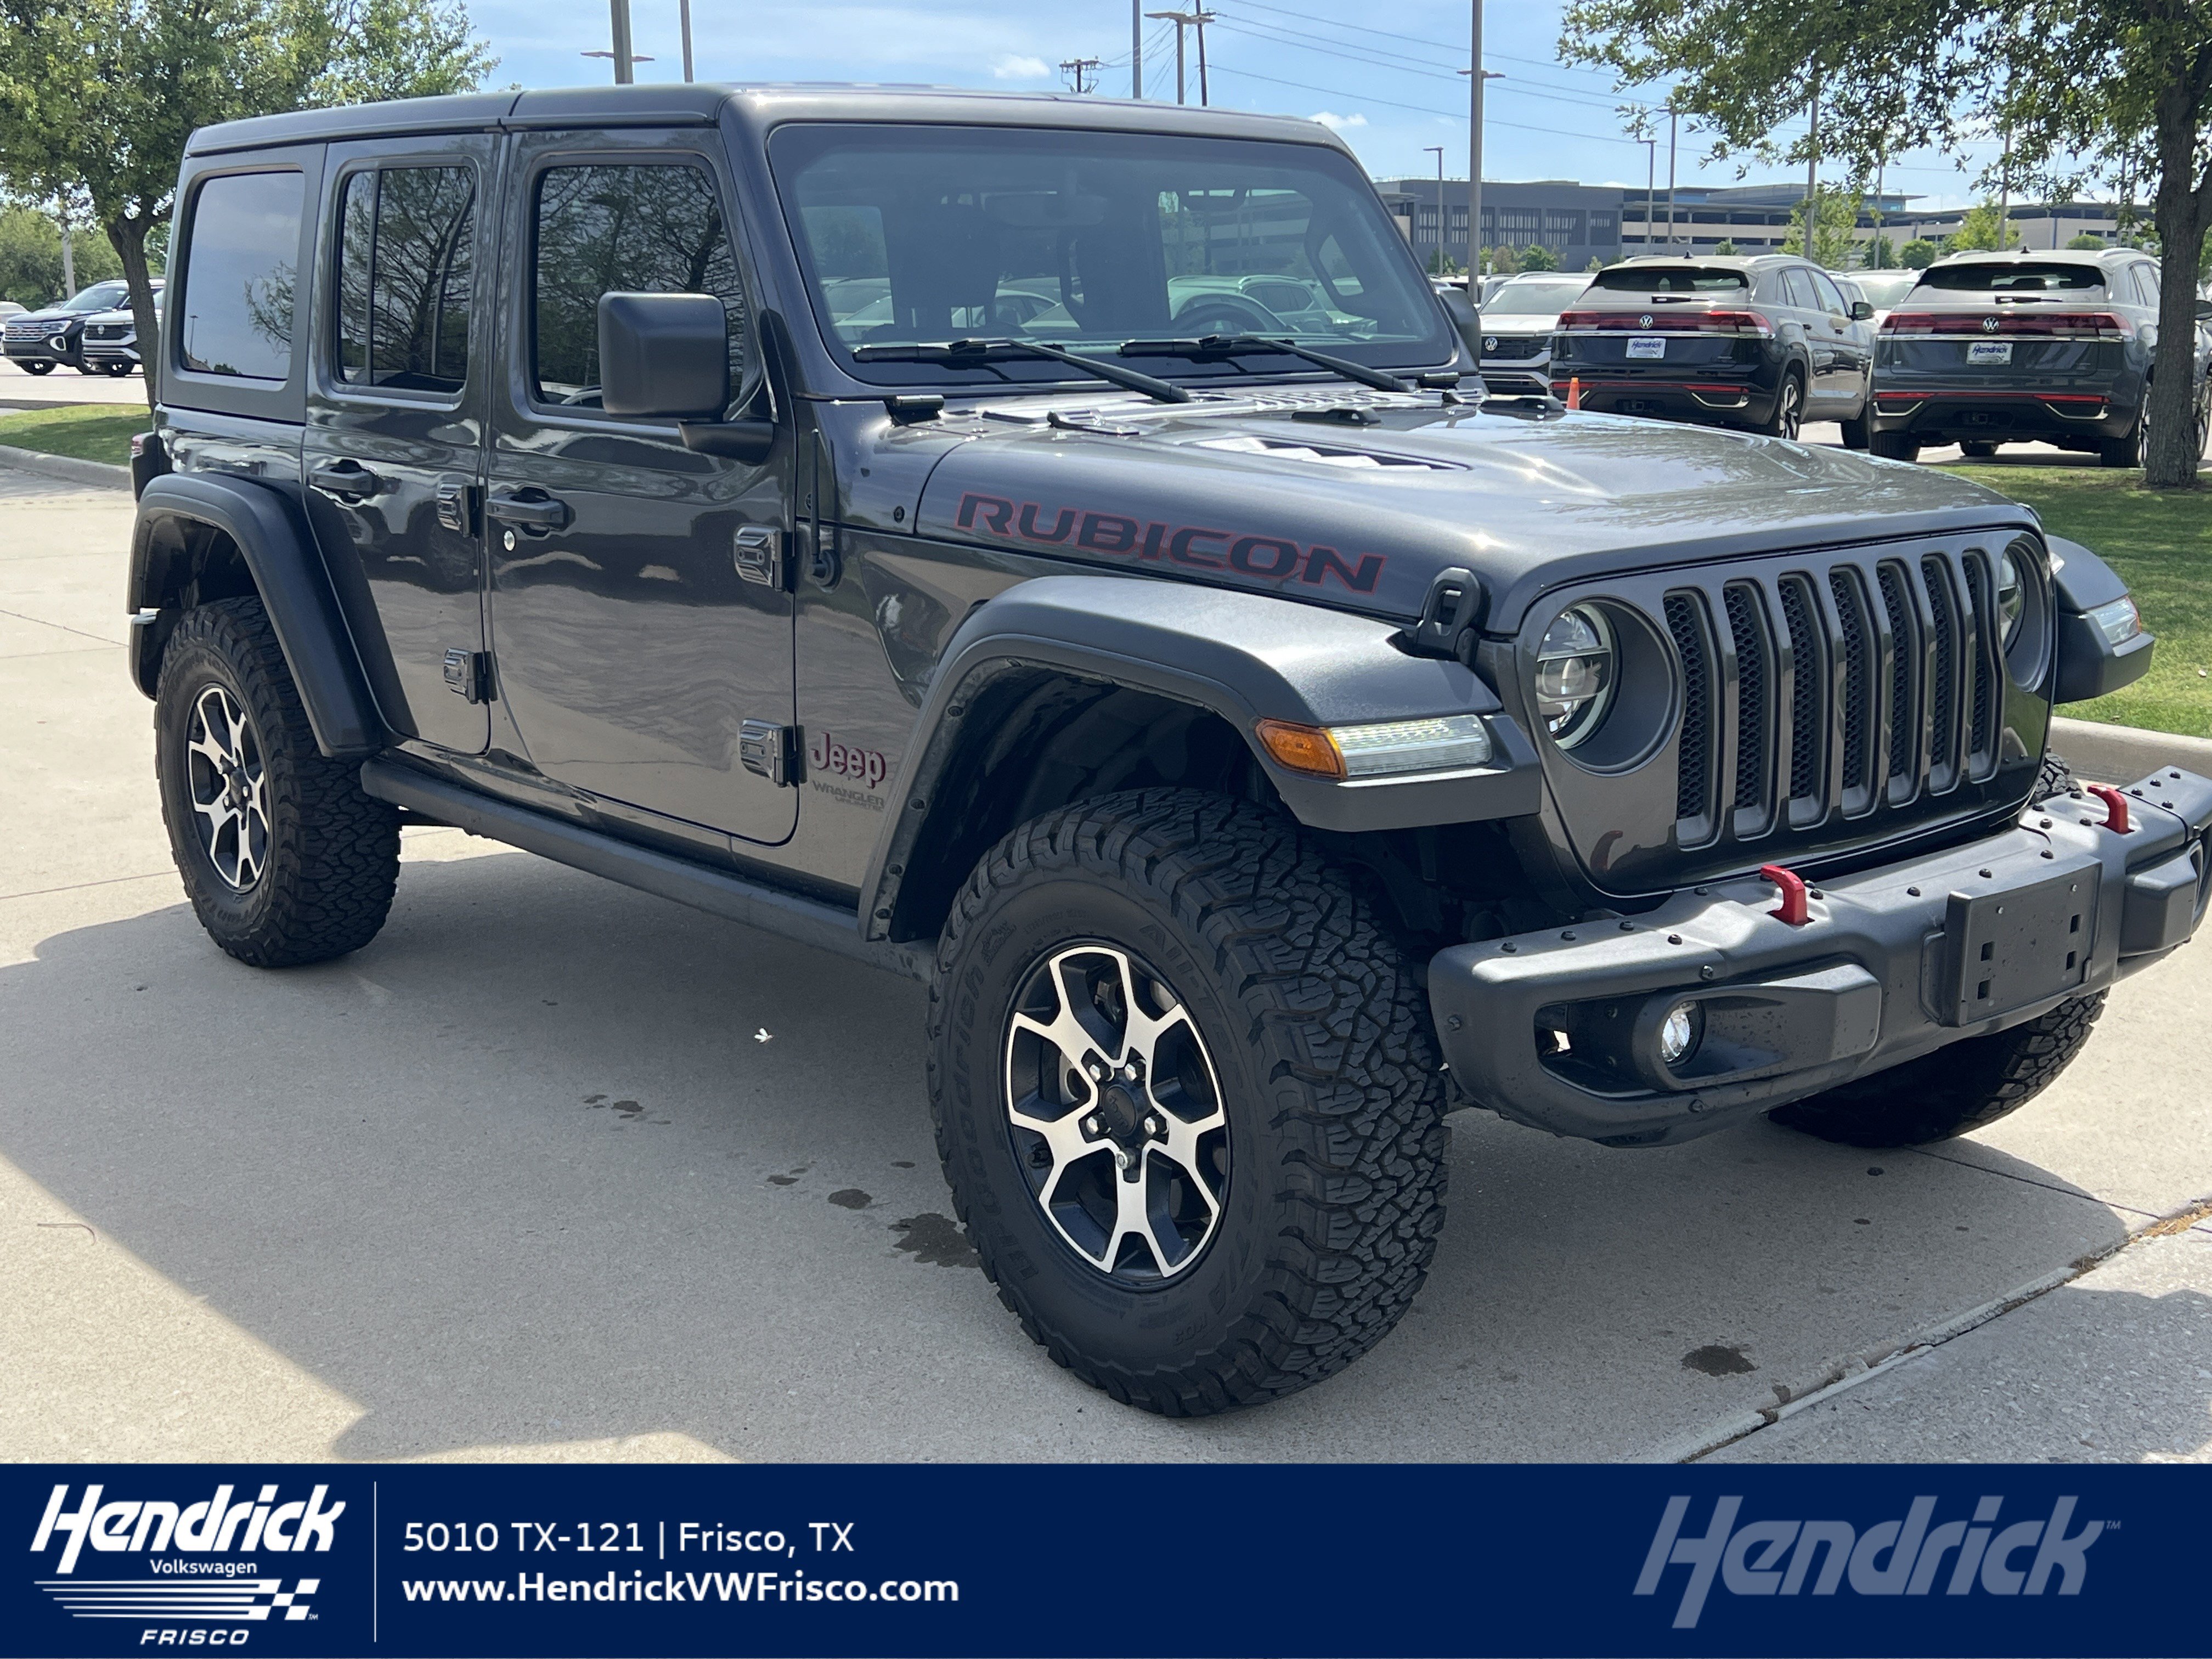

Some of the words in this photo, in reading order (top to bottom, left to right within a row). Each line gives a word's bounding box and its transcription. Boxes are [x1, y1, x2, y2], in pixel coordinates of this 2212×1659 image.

[1632, 340, 1661, 350] Hendrick
[1972, 344, 2007, 356] Hendrick
[955, 492, 1387, 596] RUBICON
[810, 732, 886, 789] Jeep
[812, 780, 884, 809] WRANGLER
